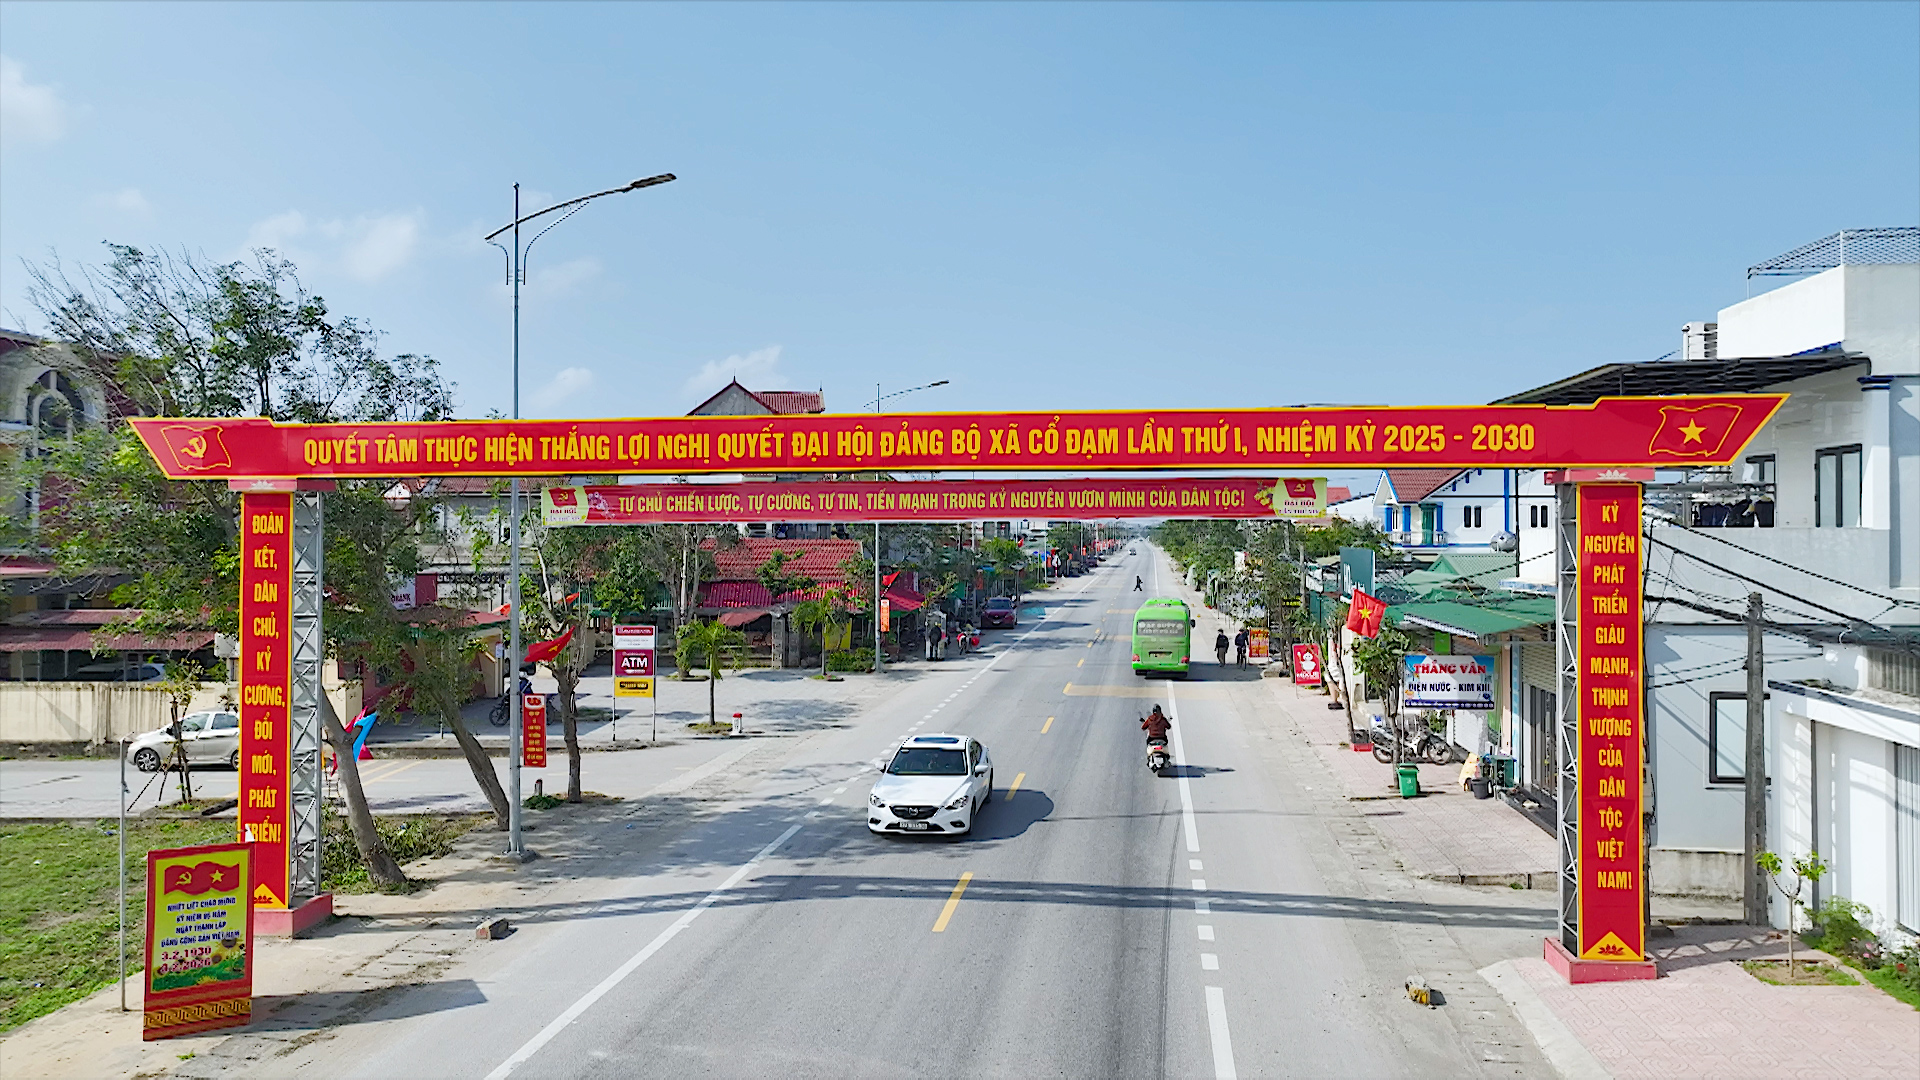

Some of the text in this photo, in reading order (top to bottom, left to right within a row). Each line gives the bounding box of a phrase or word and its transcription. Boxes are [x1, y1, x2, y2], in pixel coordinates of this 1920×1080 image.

[304, 431, 368, 466] QUYẾT
[375, 433, 418, 463] TÂM
[424, 436, 477, 468] THỰC
[484, 432, 533, 466] HIỆN
[540, 425, 610, 460] THẮNG
[617, 433, 650, 465] LỢI
[658, 433, 710, 463] NGHỊ
[718, 423, 784, 461] QUYẾT
[791, 432, 829, 462] ĐẠI
[837, 424, 873, 462] HỘI
[880, 421, 944, 457] ĐẢNG
[951, 423, 981, 460] BỘ
[989, 423, 1021, 454] XÃ
[1028, 415, 1060, 454] CỔ
[1065, 427, 1119, 459] ĐẠM
[1127, 417, 1174, 454] LẦN
[1181, 418, 1229, 454] THỨ
[1234, 427, 1247, 456] I,
[1257, 419, 1336, 458] NHIỆM
[1345, 419, 1376, 452] KỲ
[1383, 424, 1446, 452] 2025
[1471, 423, 1535, 451] 2030
[619, 485, 1245, 515] TỰ CHỦ CHIẾN LƯỢC, TỰ CƯỜNG, TỰ TIN, TIẾN MẠNH TRONG KỶ NGUYÊN VƯƠN MÌNH CỦA DÂN TỘC!
[1602, 500, 1619, 523] KỶ
[252, 512, 284, 534] ĐOÀN
[1584, 532, 1635, 554] NGUYÊN
[254, 544, 277, 571] KẾT,
[1593, 562, 1625, 584] PHÁT
[254, 579, 277, 602] DÂN
[1592, 588, 1628, 614] TRIỂN
[253, 612, 279, 639] CHỦ,
[1595, 623, 1625, 645] GIÀU
[256, 645, 271, 671] KỶ
[621, 657, 648, 668] ATM
[1460, 661, 1487, 674] VÂN
[1590, 657, 1634, 678] MẠNH,
[244, 684, 286, 708] CƯƠNG,
[1459, 683, 1474, 692] KIM
[1592, 687, 1628, 709] THỊNH
[254, 712, 273, 740] ĐỔI
[1589, 718, 1632, 740] VƯỢNG
[252, 750, 276, 775] MỚI,
[1598, 743, 1623, 767] CỦA
[249, 786, 278, 808] PHÁT
[1599, 775, 1625, 798] DÂN
[1598, 806, 1623, 832] TỘC
[1597, 837, 1624, 862] VIỆT
[1597, 871, 1633, 890] NAM!
